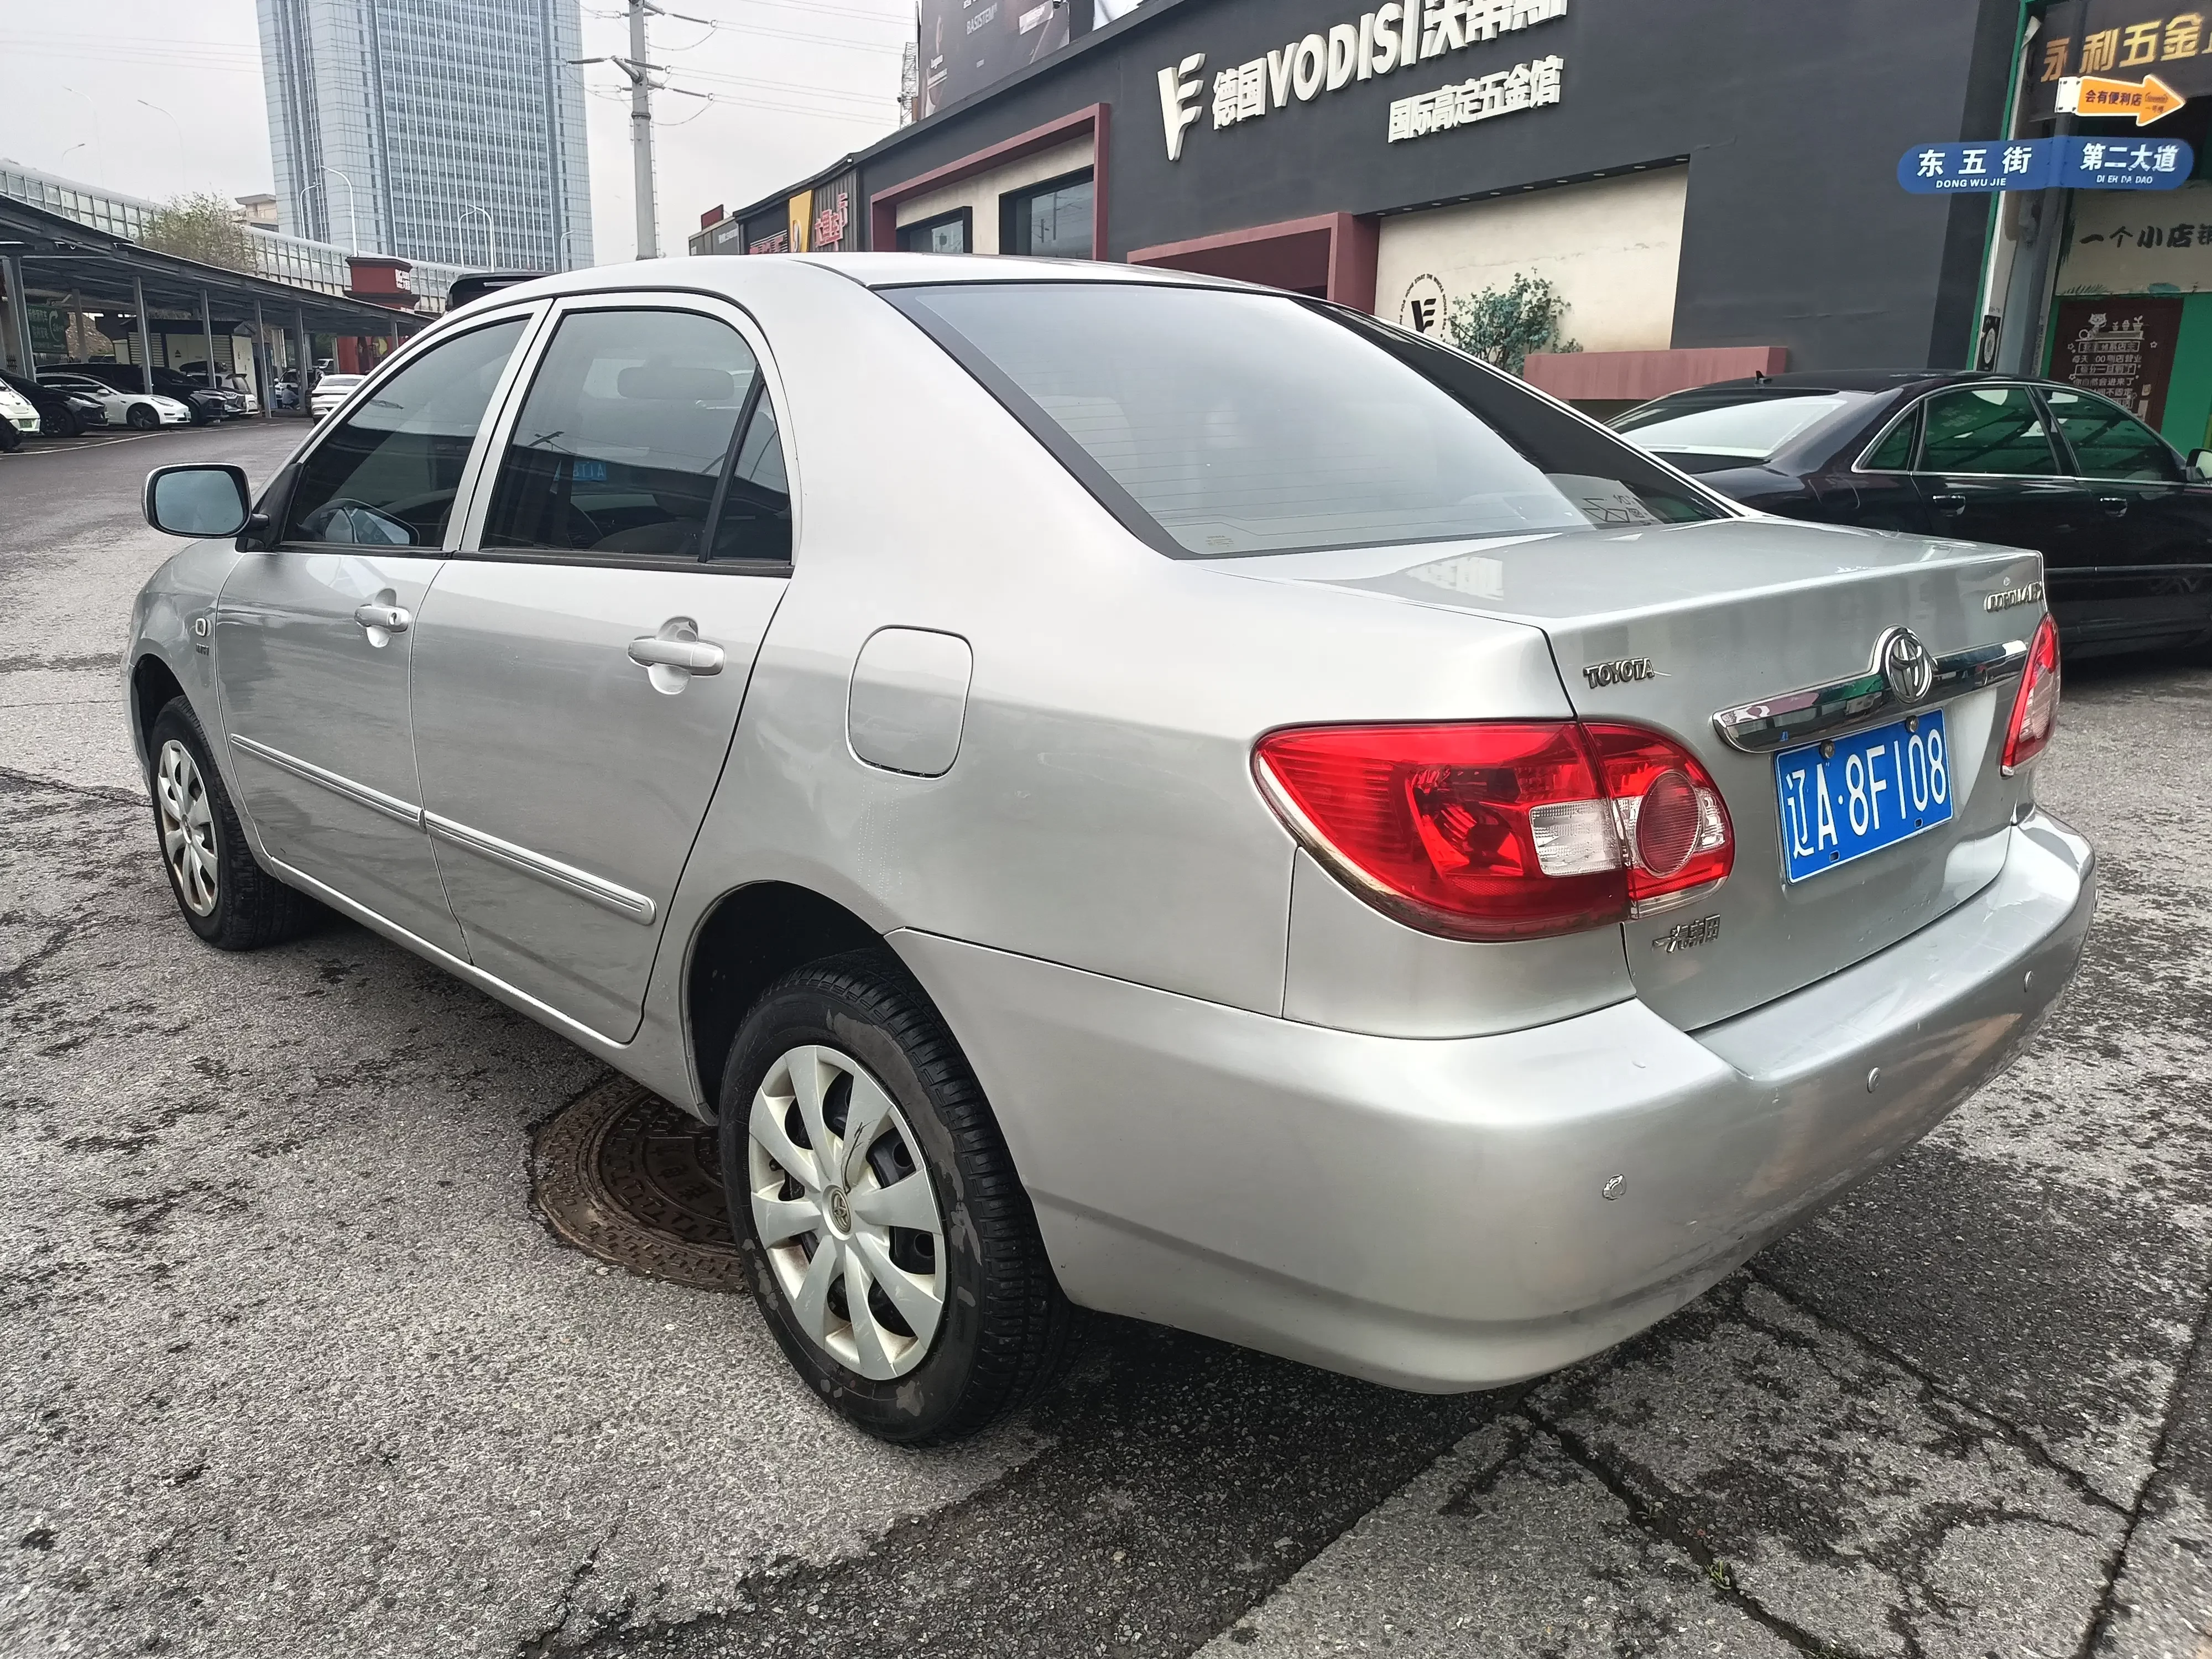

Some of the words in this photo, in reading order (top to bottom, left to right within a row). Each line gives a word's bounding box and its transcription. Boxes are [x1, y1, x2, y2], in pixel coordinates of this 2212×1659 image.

[2041, 12, 2212, 83] 永利五金
[1388, 55, 1564, 143] 国际高定五金馆
[2085, 90, 2142, 107] 会有便利店
[1916, 145, 2032, 178] 东五街
[2080, 143, 2179, 173] 第二大道
[1936, 178, 1967, 189] DONG
[1970, 178, 1988, 187] WU
[1990, 178, 2007, 187] JIE
[2096, 175, 2105, 184] DI
[2135, 175, 2153, 184] DAO
[1583, 656, 1655, 690] TOYOTA
